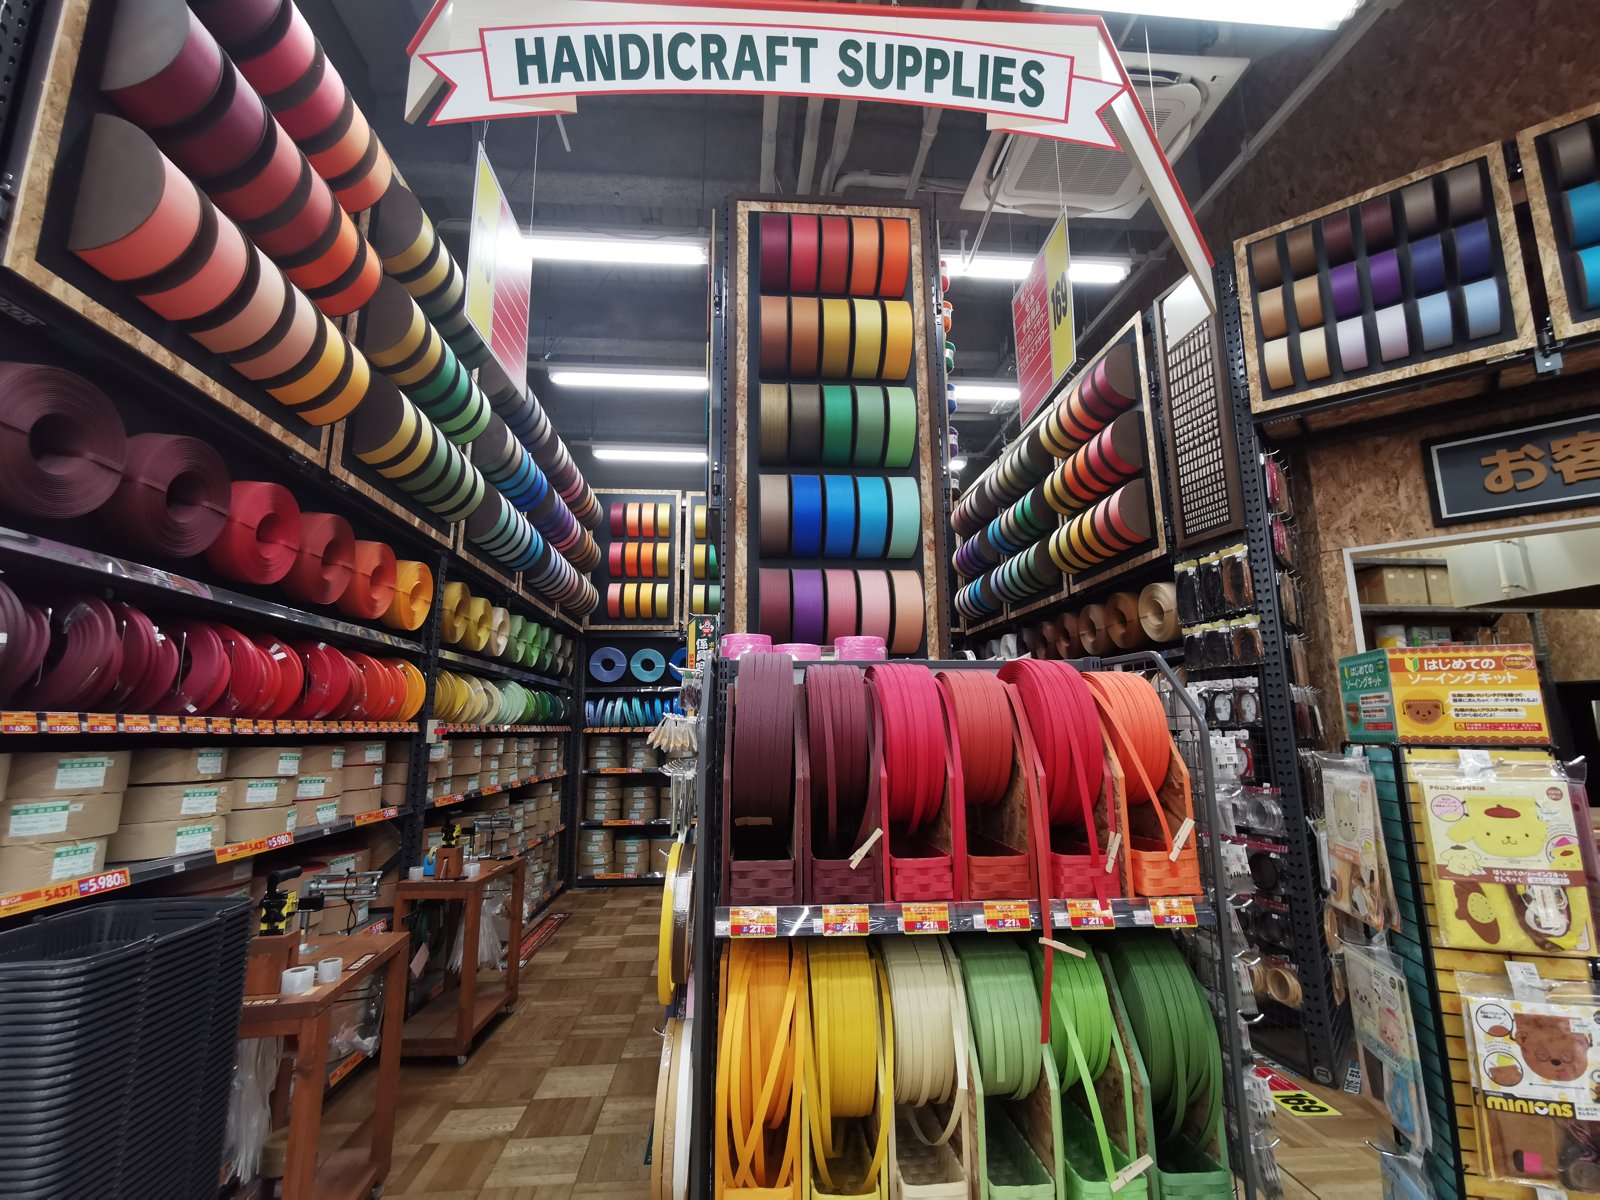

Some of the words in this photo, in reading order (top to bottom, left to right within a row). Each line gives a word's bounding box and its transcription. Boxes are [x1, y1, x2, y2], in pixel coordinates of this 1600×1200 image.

[514, 31, 820, 86] HANDICRAFT
[836, 38, 1046, 109] SUPPLIES
[1051, 271, 1068, 331] 169
[1481, 431, 1600, 493] お客
[1349, 663, 1374, 676] はじめての
[1423, 658, 1496, 671] はじめての
[1345, 675, 1382, 689] ソーイングキット
[1408, 671, 1518, 685] ソーイングキット
[1274, 1093, 1329, 1112] 169
